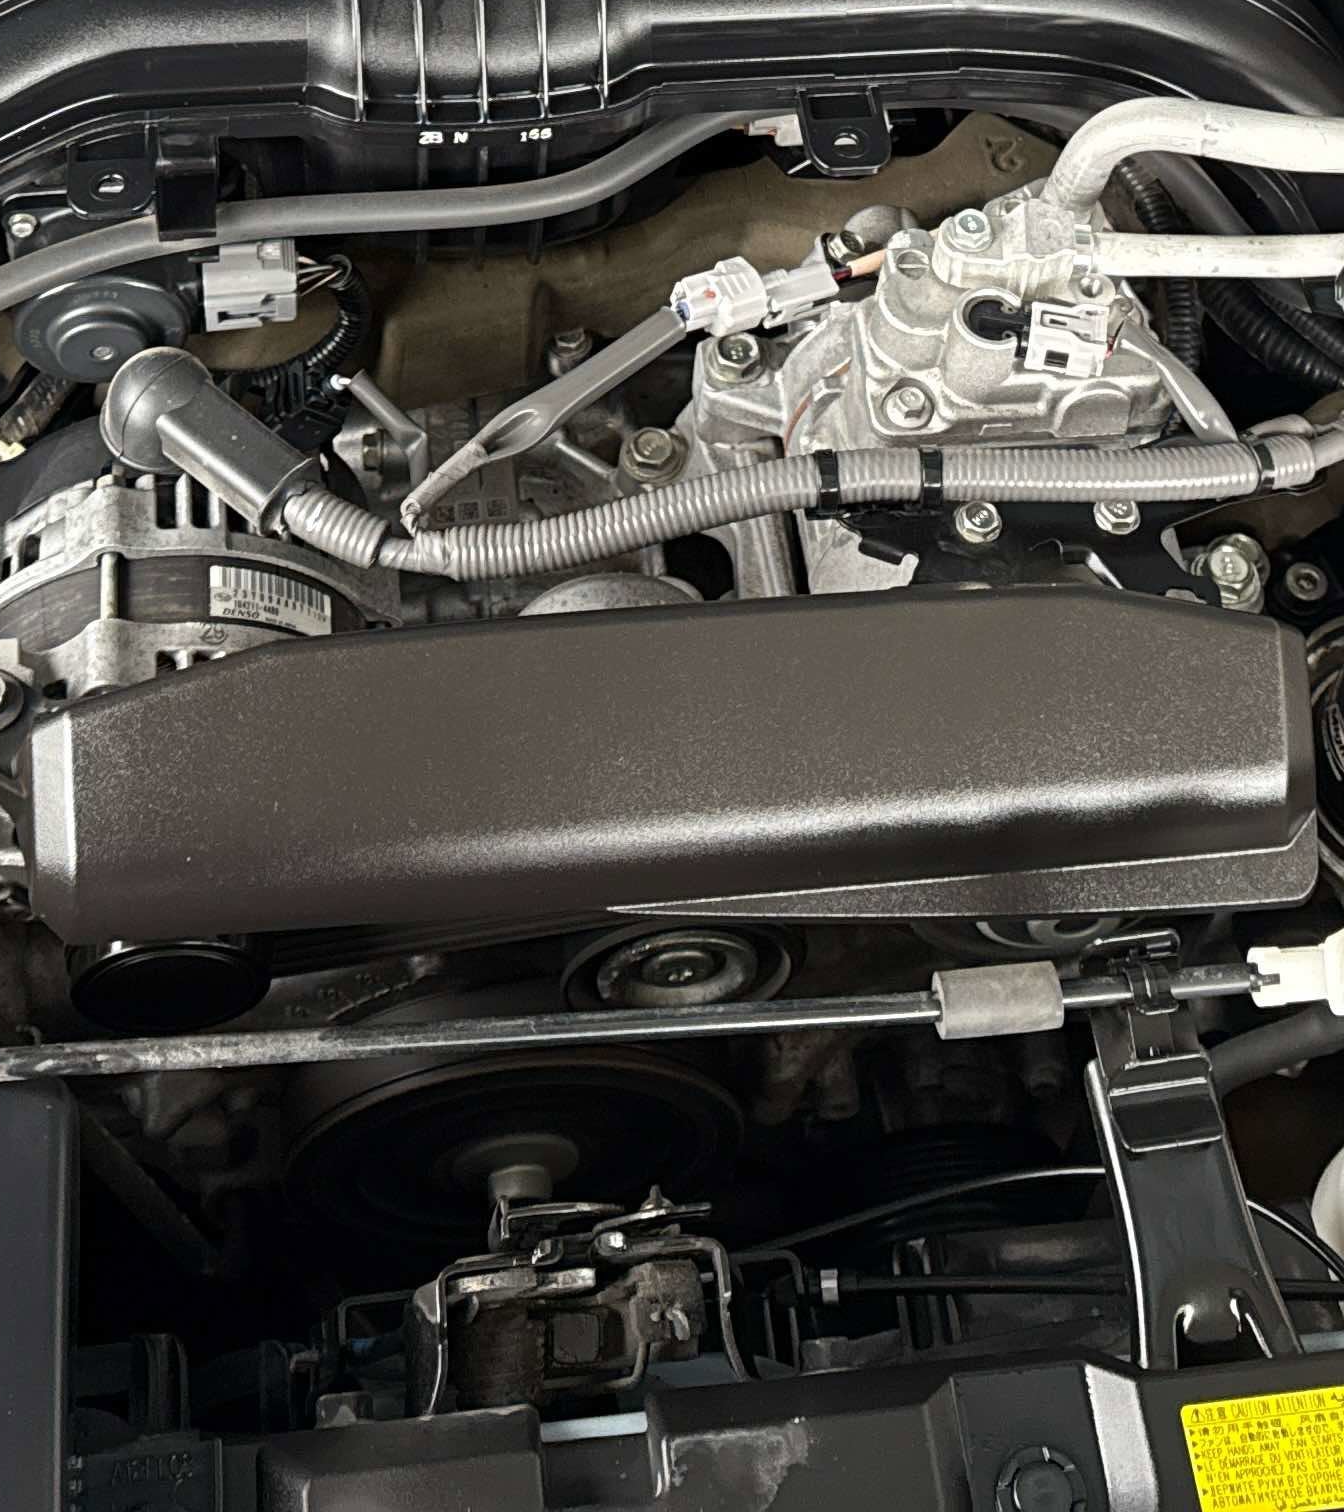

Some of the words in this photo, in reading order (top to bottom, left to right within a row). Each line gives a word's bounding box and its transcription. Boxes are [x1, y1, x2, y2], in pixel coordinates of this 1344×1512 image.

[222, 606, 260, 619] DENSO
[1231, 1400, 1271, 1419] CAUTION
[1275, 1393, 1326, 1413] ATTENTION
[1200, 1448, 1222, 1459] KEEP
[1227, 1444, 1254, 1456] HANDS
[1290, 1438, 1307, 1448] FAN
[1311, 1433, 1344, 1446] STARTS
[1204, 1461, 1216, 1471] LE
[1218, 1453, 1264, 1469] DÉMARRAGE
[1269, 1453, 1281, 1463] DU
[1285, 1446, 1341, 1461] VENTILATEUR
[1235, 1464, 1284, 1479] APPROCHEZ
[1289, 1461, 1307, 1473] PAS
[1312, 1458, 1329, 1470] LES
[1210, 1481, 1255, 1496] ДЕРЖИТЕ
[1258, 1477, 1285, 1490] РУКИ
[1287, 1476, 1294, 1486] В
[1211, 1486, 1304, 1508] АВТОМАТИЧЕСКОЕ
